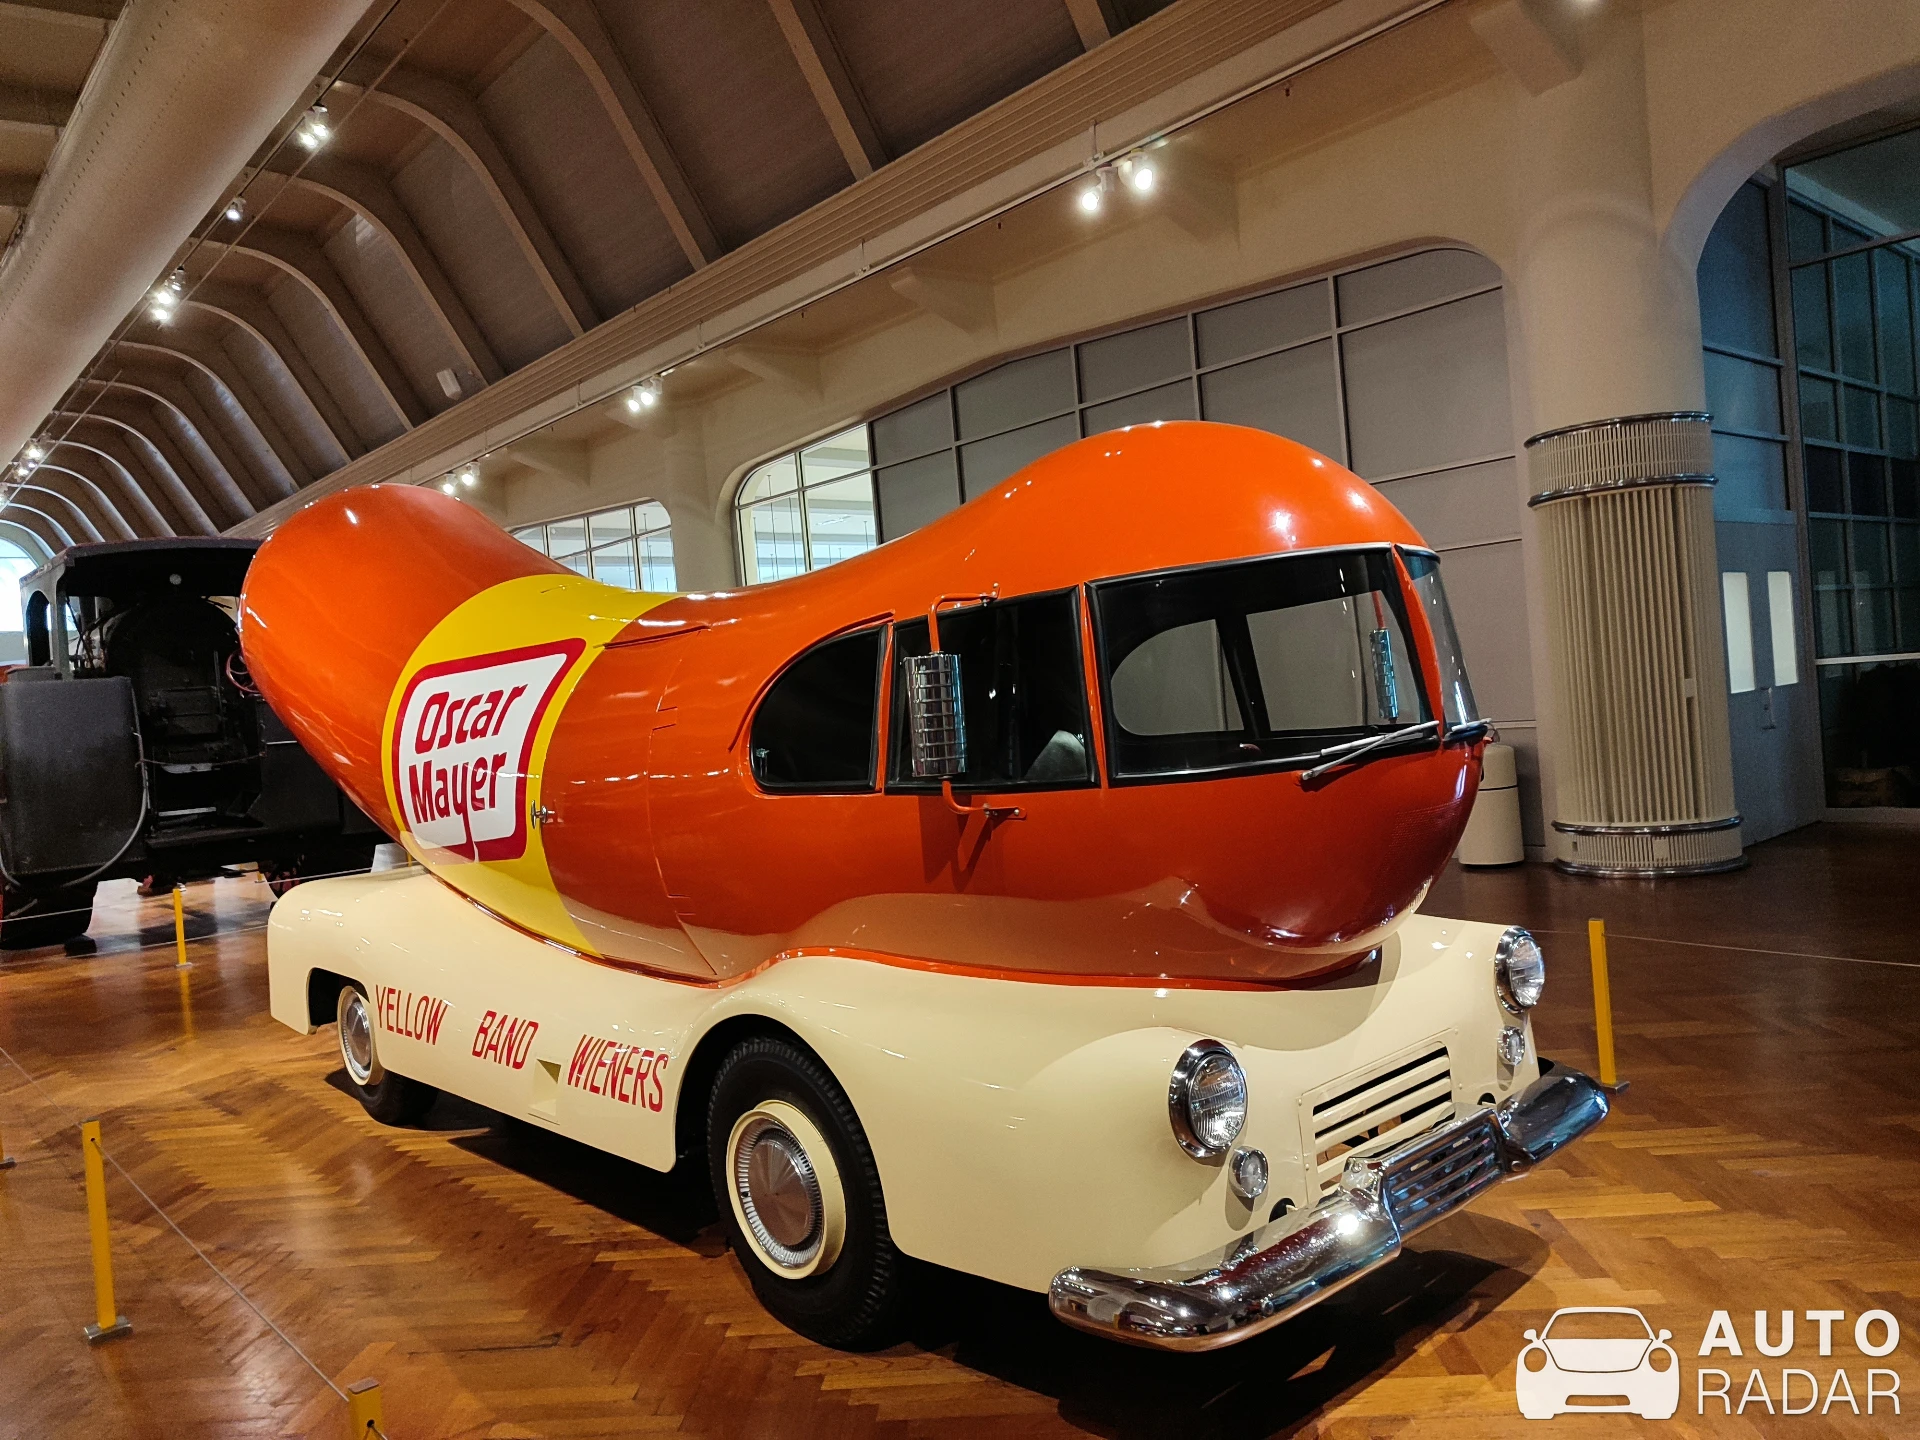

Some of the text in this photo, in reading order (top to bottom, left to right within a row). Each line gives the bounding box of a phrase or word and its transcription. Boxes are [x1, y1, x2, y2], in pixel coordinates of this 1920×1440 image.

[414, 683, 528, 755] Oscar
[408, 751, 507, 844] Mayer
[375, 984, 669, 1113] YELLOW BAND WIENERS
